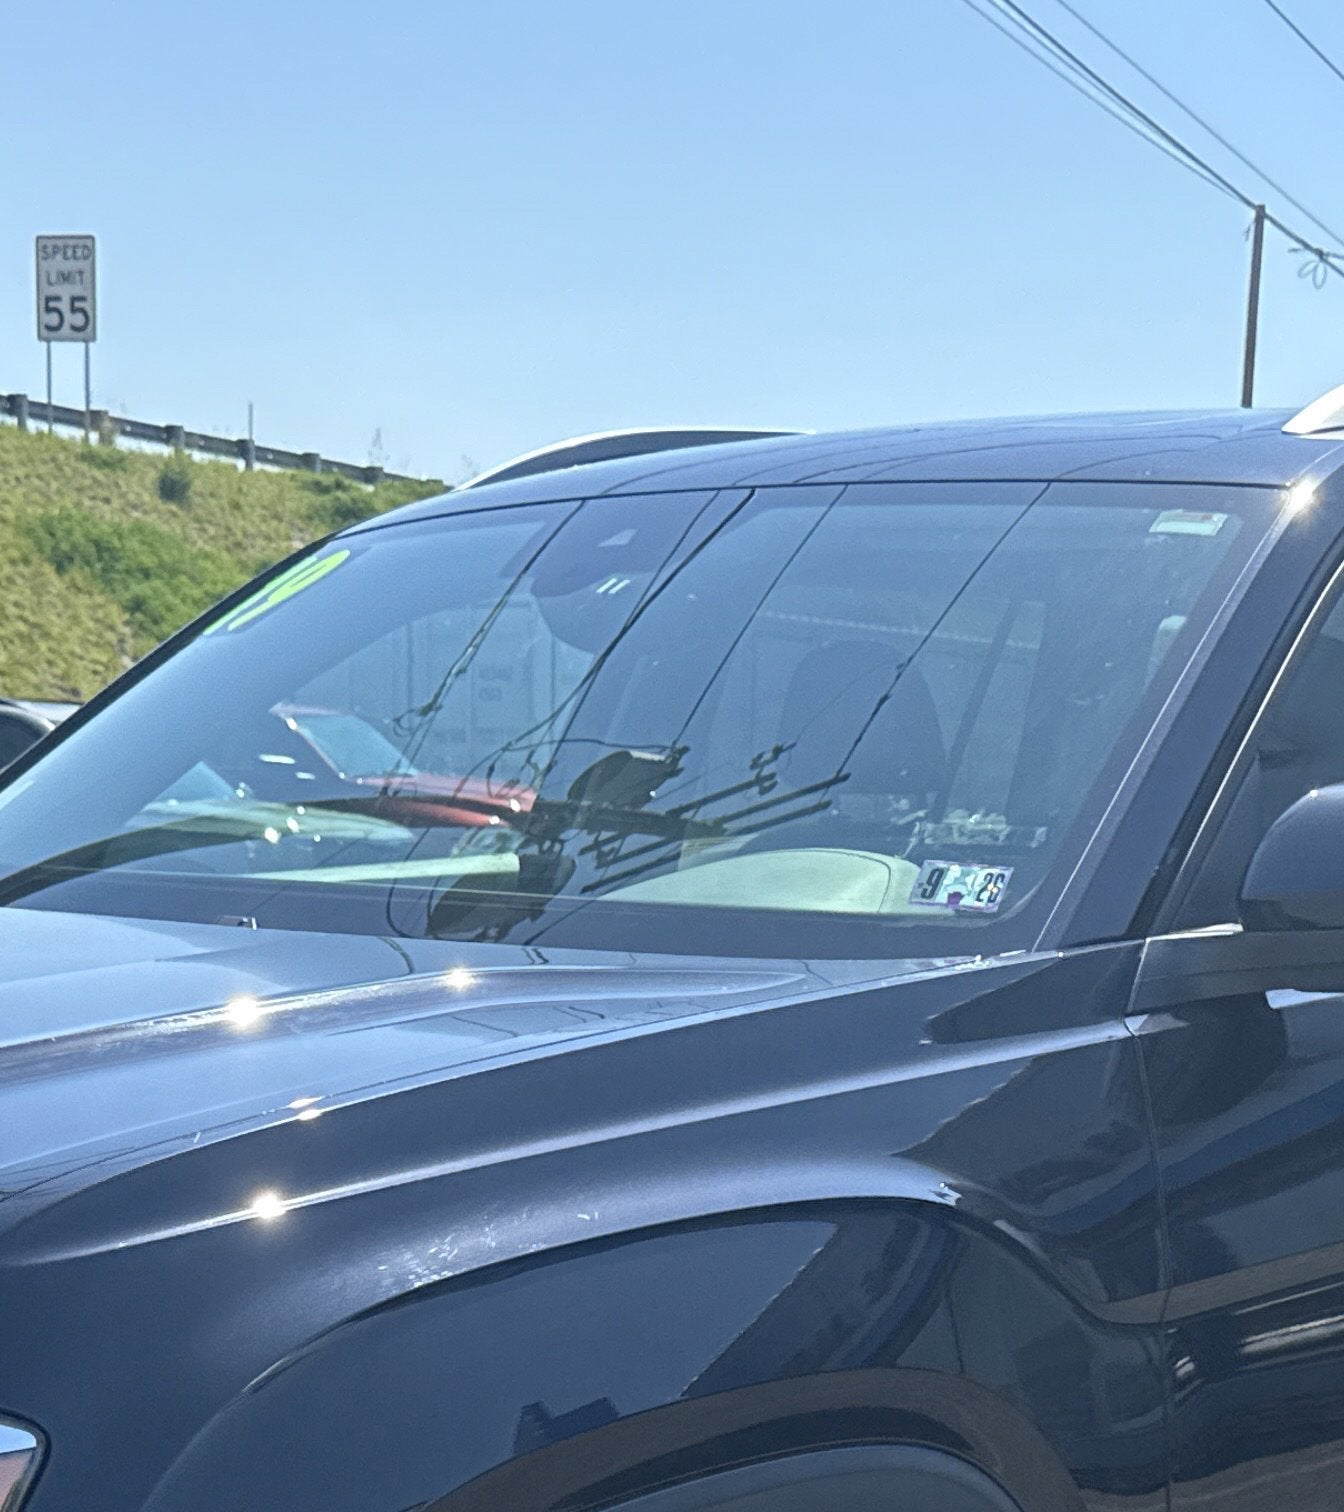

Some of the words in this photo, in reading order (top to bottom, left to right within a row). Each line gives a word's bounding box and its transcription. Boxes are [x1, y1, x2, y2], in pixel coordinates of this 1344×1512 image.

[41, 244, 92, 261] SPEED
[46, 270, 84, 286] LIMIT
[44, 295, 90, 332] 55
[920, 867, 945, 901] 9
